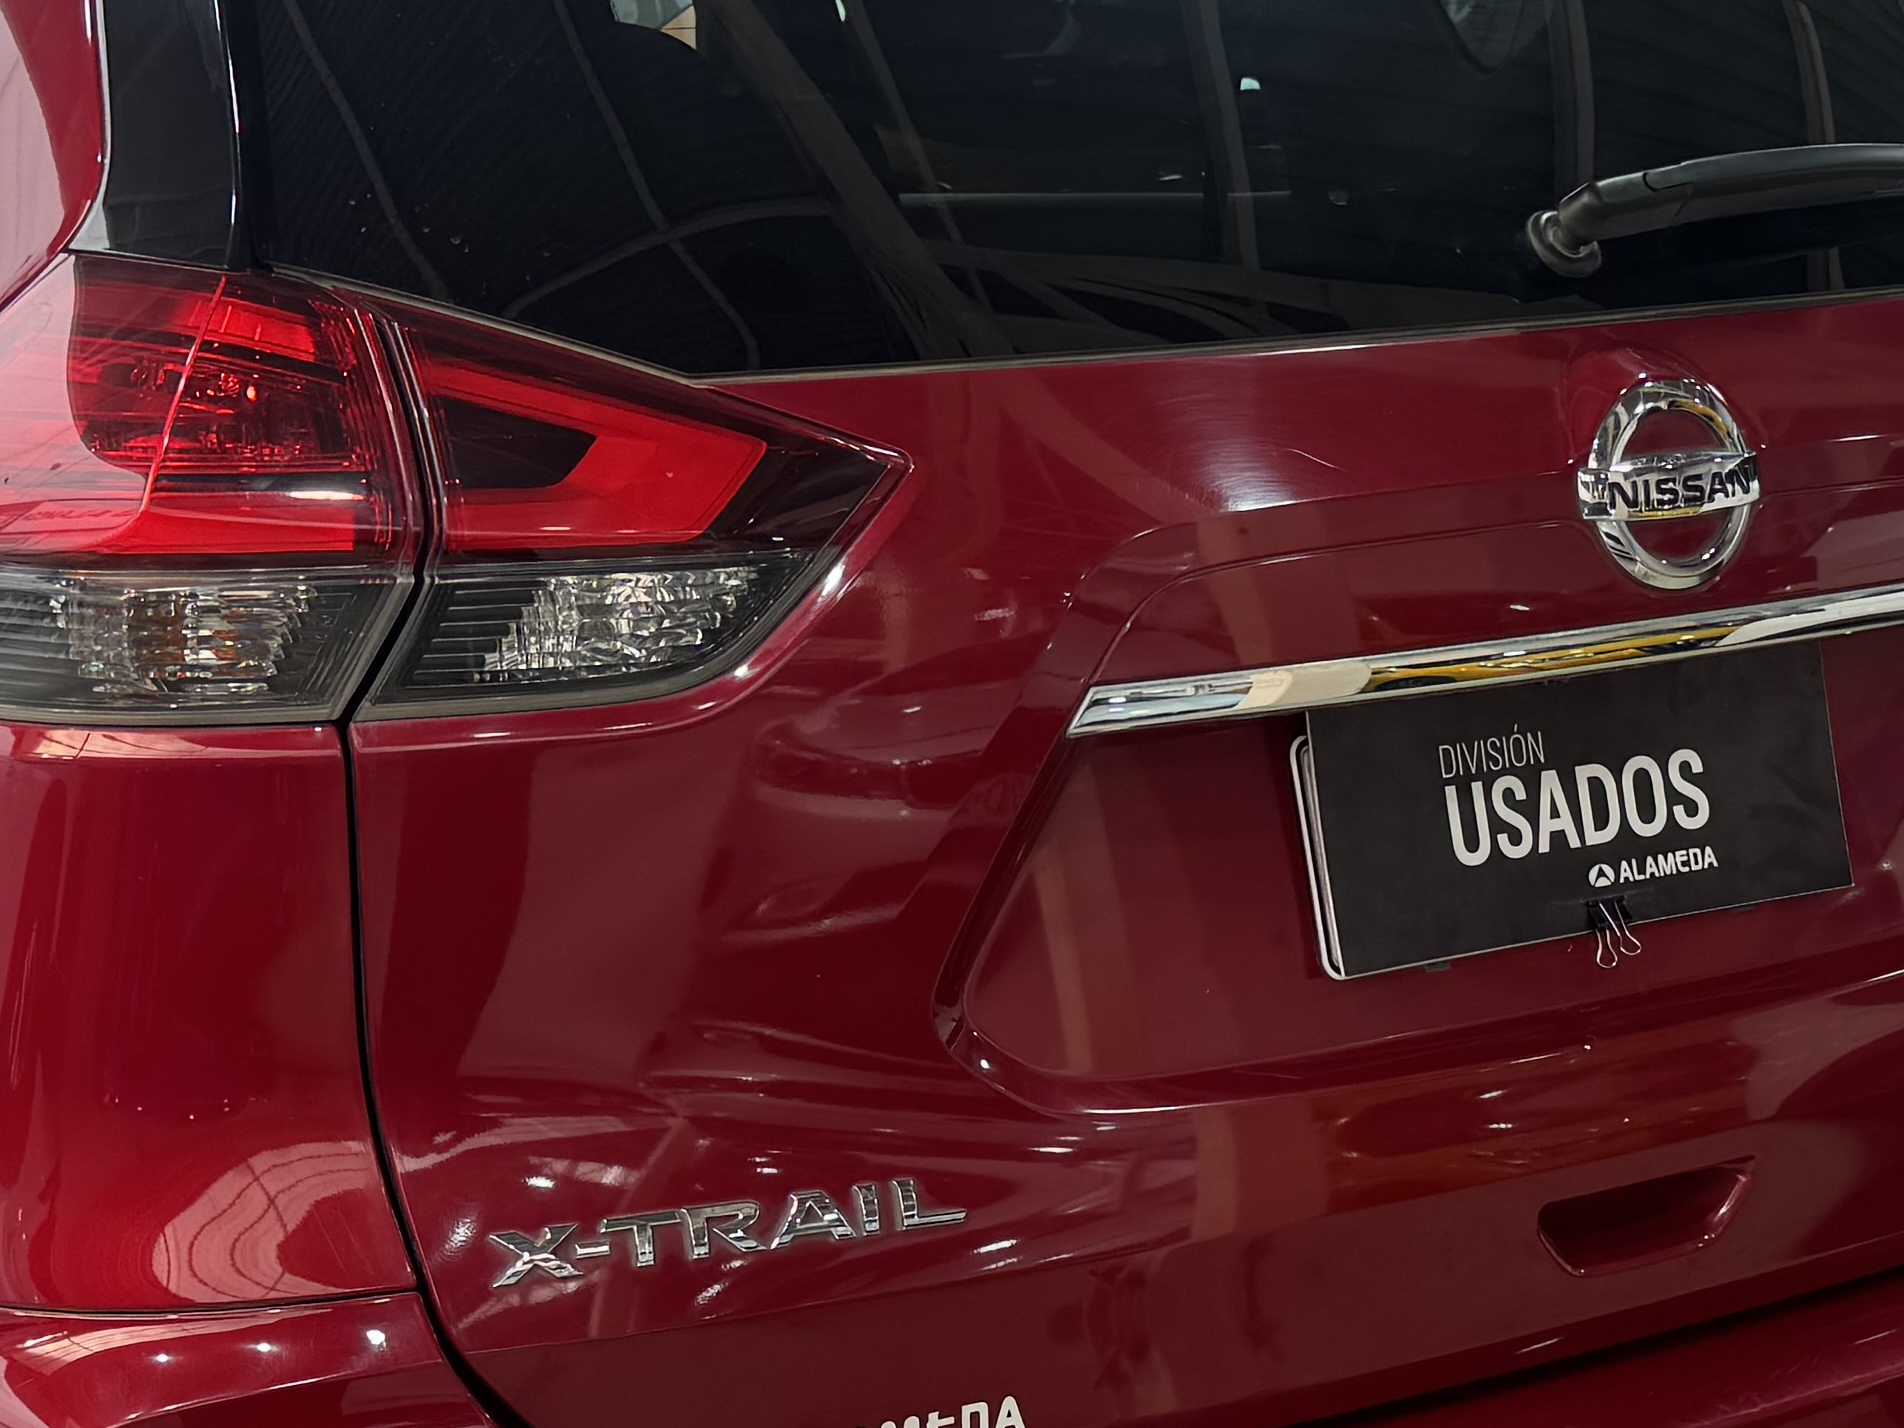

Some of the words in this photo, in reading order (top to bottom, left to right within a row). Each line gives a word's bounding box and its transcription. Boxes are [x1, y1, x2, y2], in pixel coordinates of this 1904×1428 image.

[1607, 455, 1758, 512] NISSAN
[1438, 723, 1545, 779] DIVISIÓN
[1444, 748, 1710, 867] USADOS
[1619, 845, 1719, 884] ALAMEDA
[488, 1177, 968, 1289] X-TRAIL
